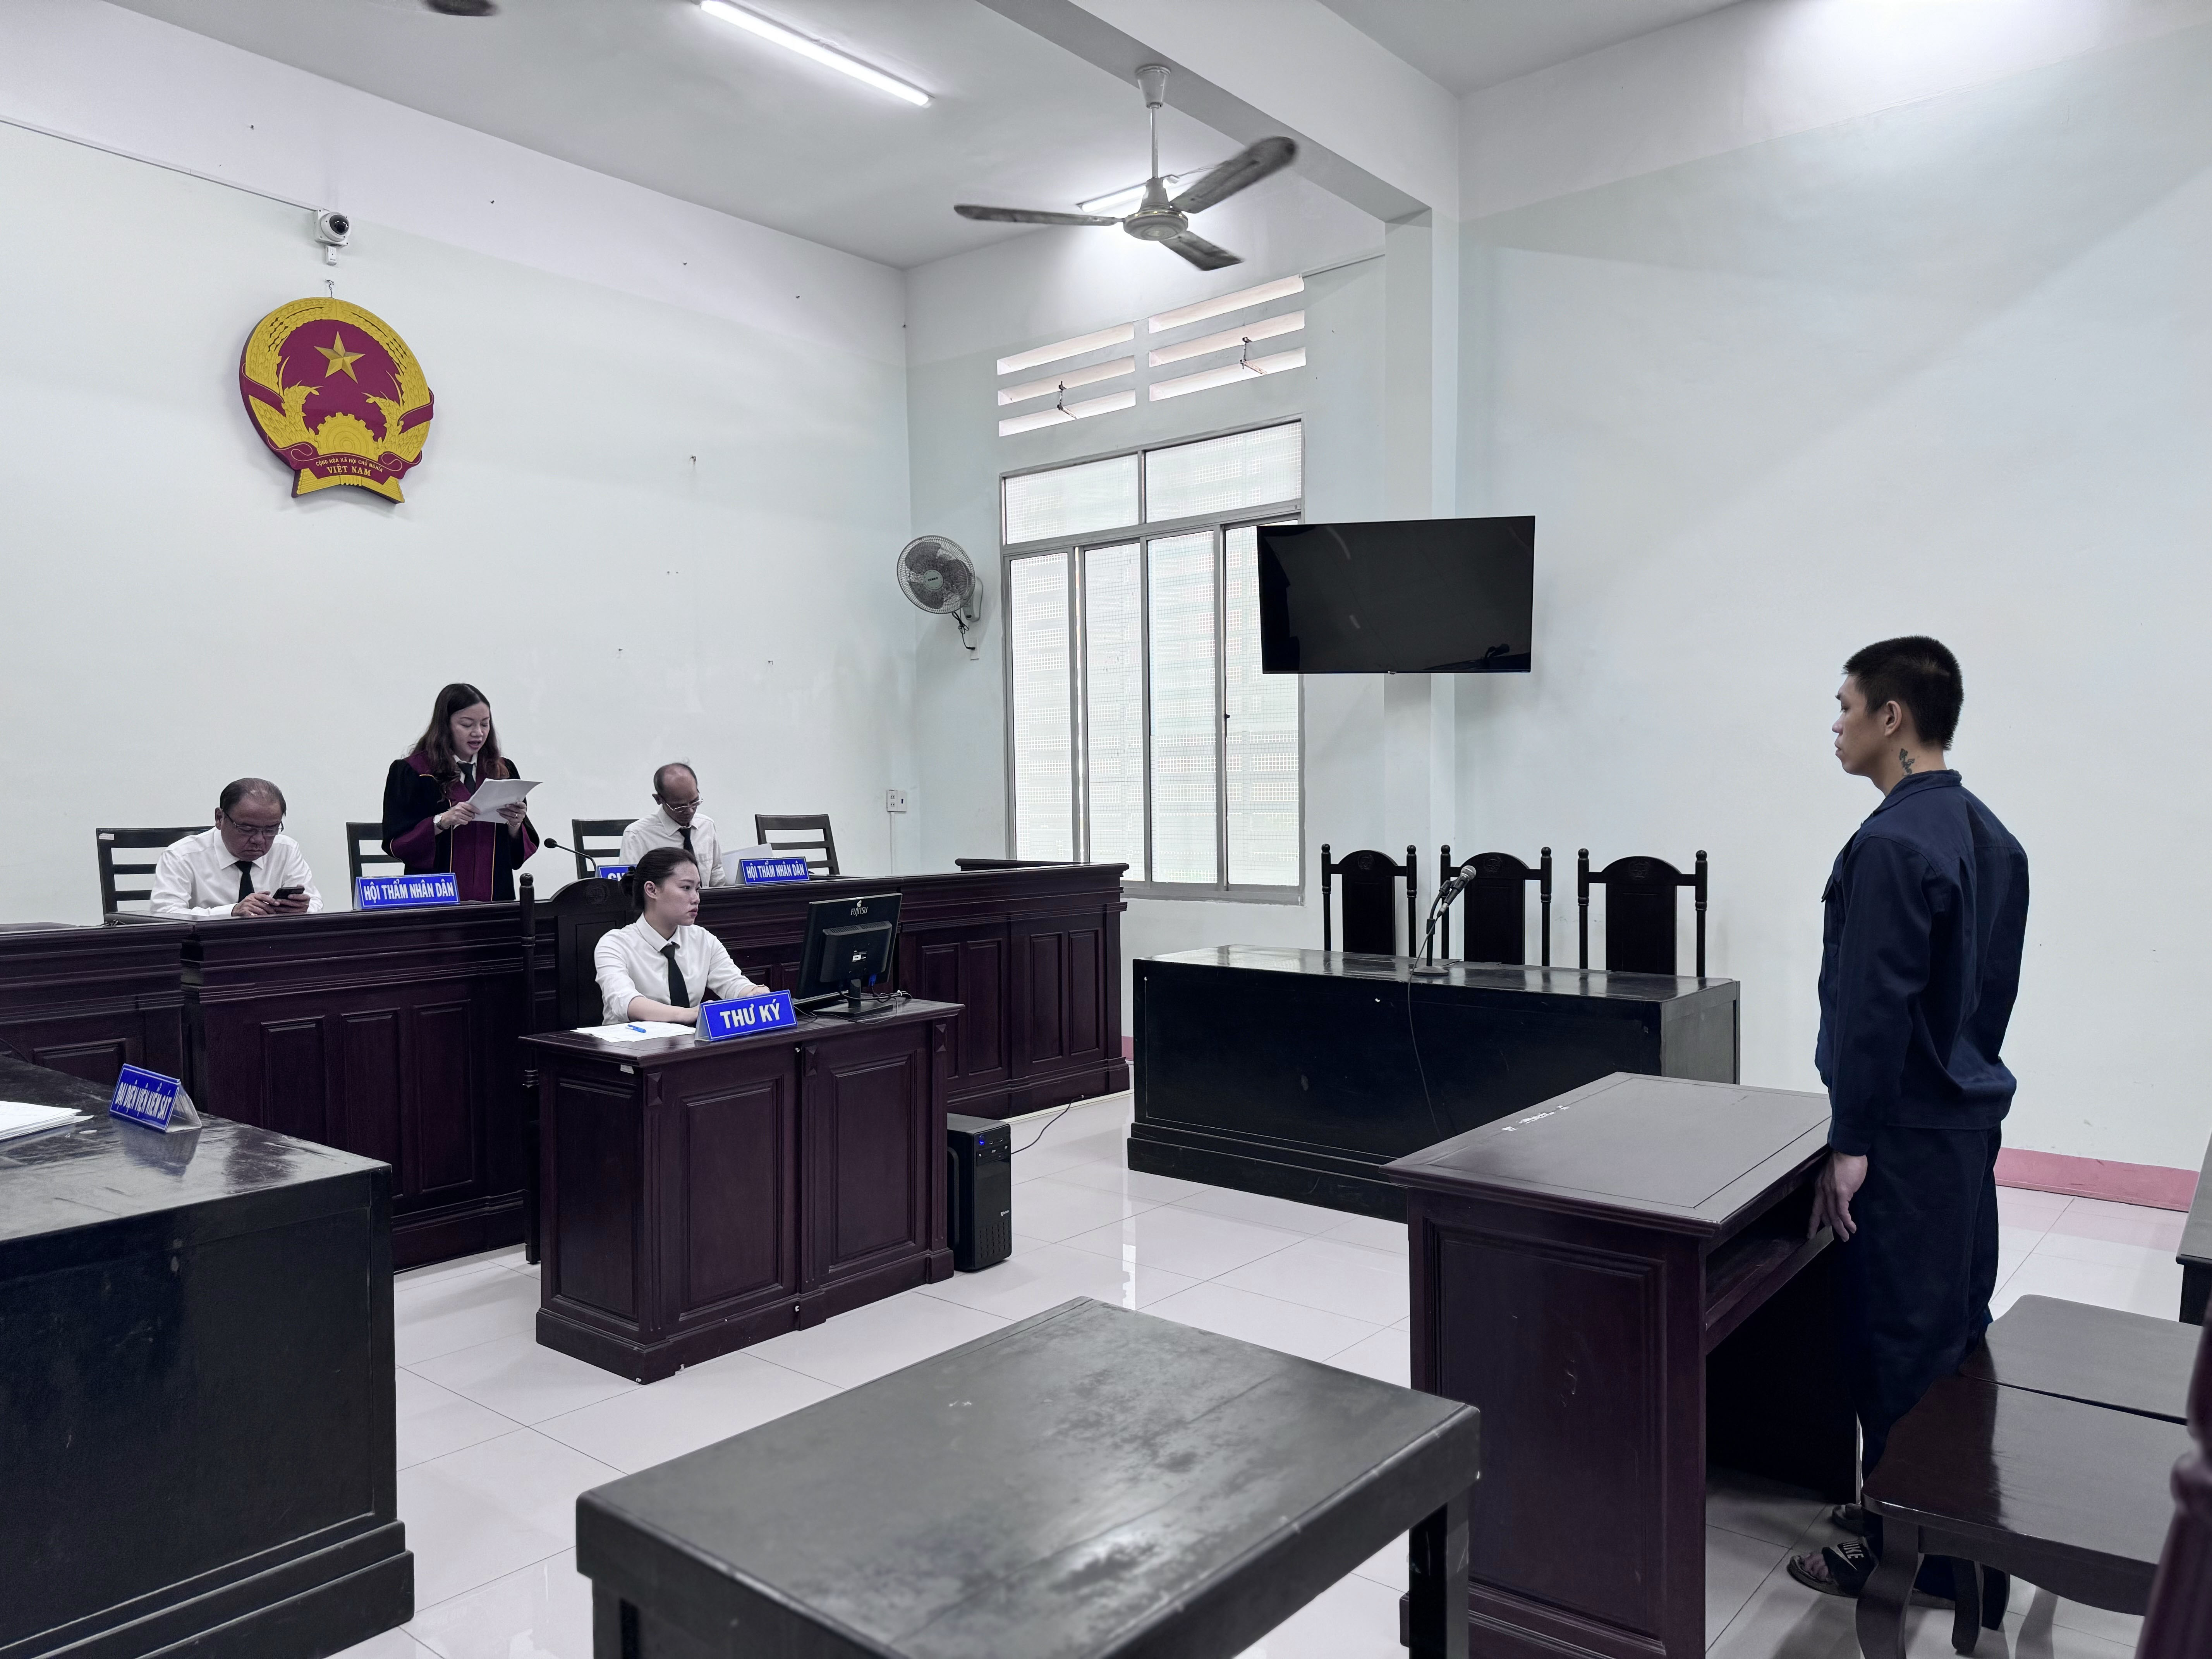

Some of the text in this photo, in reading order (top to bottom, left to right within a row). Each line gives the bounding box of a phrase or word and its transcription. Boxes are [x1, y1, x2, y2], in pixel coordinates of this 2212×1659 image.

[326, 464, 371, 476] VIỆT NAM
[746, 860, 805, 881] HỘI THẨM NHÂN DÂN
[363, 878, 455, 904] HỘI THẨM NHÂN DÂN
[850, 906, 868, 917] FUJITSU
[720, 998, 780, 1029] THƯ KÝ
[115, 1079, 172, 1120] ĐẠI DIỆN VIỆN KIỂM SÁT
